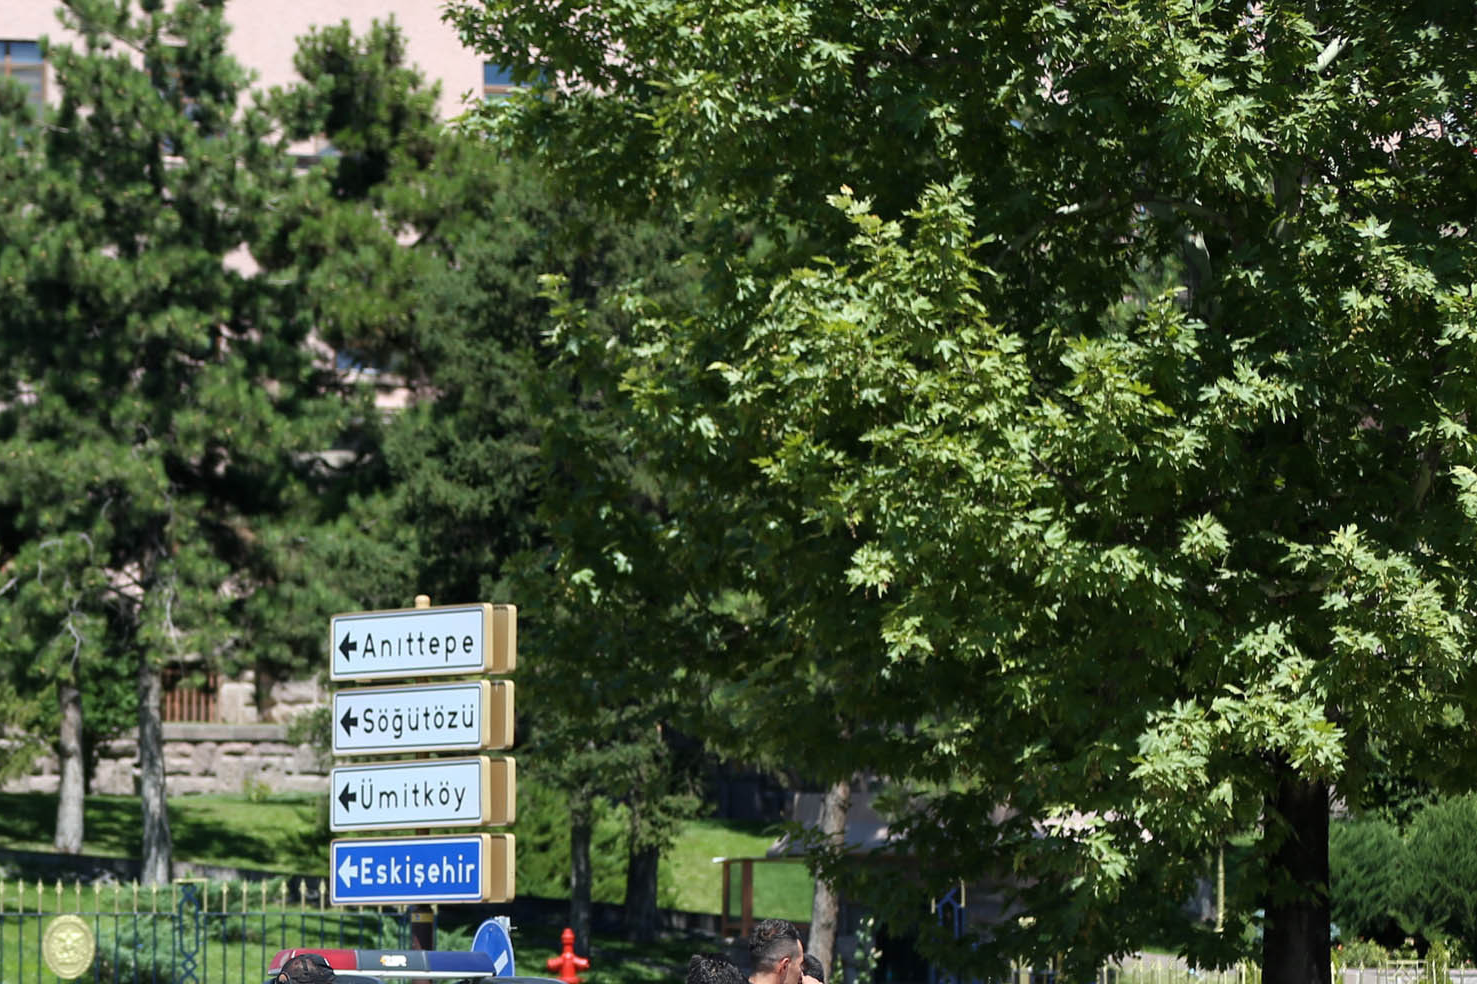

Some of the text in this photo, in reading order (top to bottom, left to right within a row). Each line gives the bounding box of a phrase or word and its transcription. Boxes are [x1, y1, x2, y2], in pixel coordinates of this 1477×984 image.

[362, 632, 474, 662] Anıttepe
[362, 704, 474, 739] Söğütözü
[360, 778, 466, 811] Ümitköy
[360, 855, 475, 887] Eskişehir
